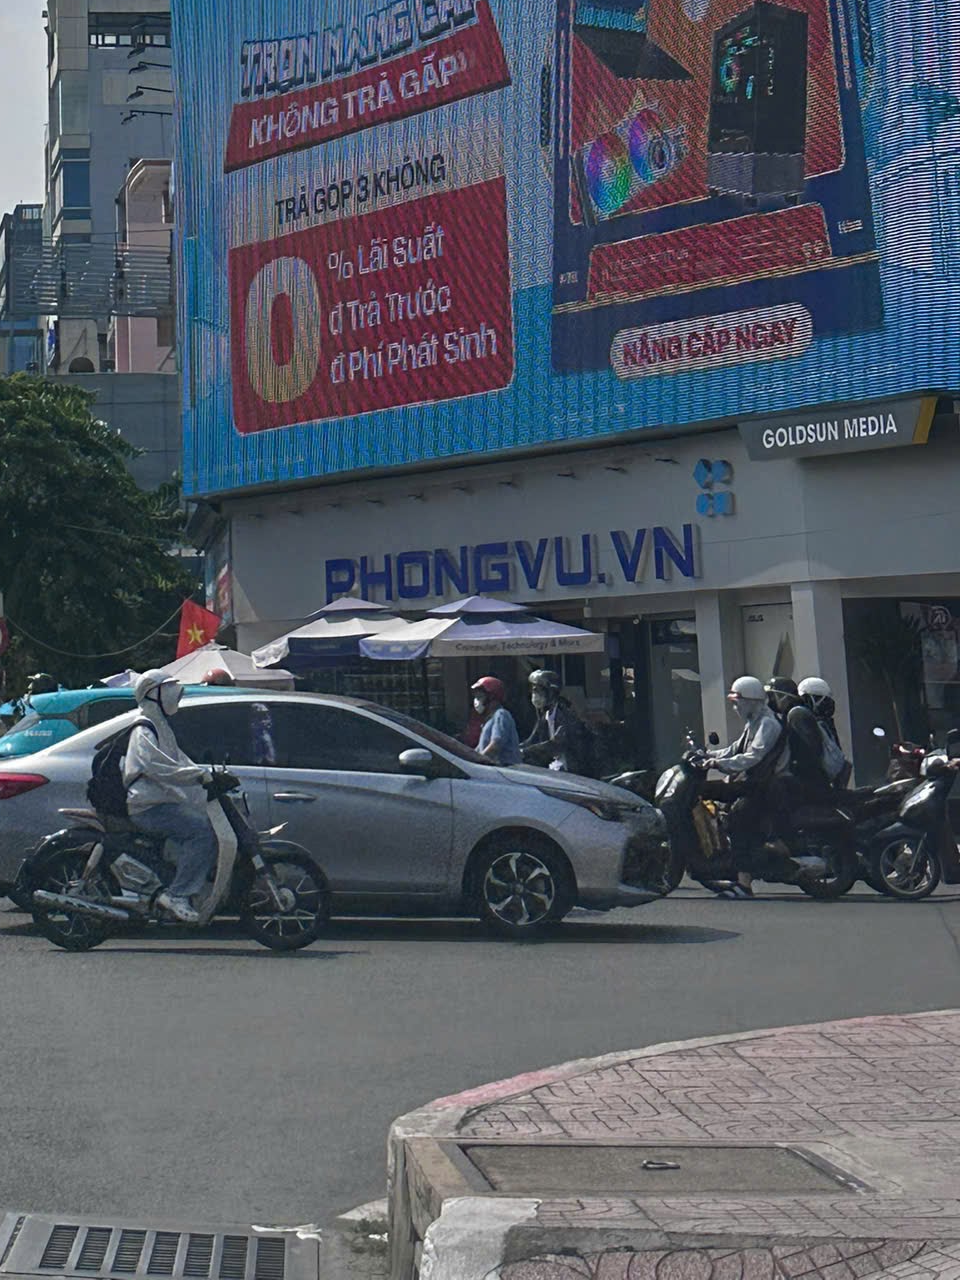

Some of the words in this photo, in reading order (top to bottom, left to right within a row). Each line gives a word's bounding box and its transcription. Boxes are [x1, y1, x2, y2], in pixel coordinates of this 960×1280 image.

[247, 100, 339, 149] KHÔNG
[343, 72, 396, 120] TRẢ
[275, 185, 309, 224] TRẢ
[357, 175, 369, 203] 3
[374, 153, 447, 197] KHÔNG
[358, 237, 389, 275] Lãi
[393, 221, 445, 268] Suất
[347, 291, 381, 331] Trả
[385, 278, 451, 322] Trước
[349, 339, 384, 381] Phí
[443, 322, 497, 364] Sinh
[735, 319, 796, 351] NGAY
[762, 421, 839, 449] GOLDSUN
[844, 413, 898, 439] MEDIA
[325, 523, 696, 605] PHONGVU.VN
